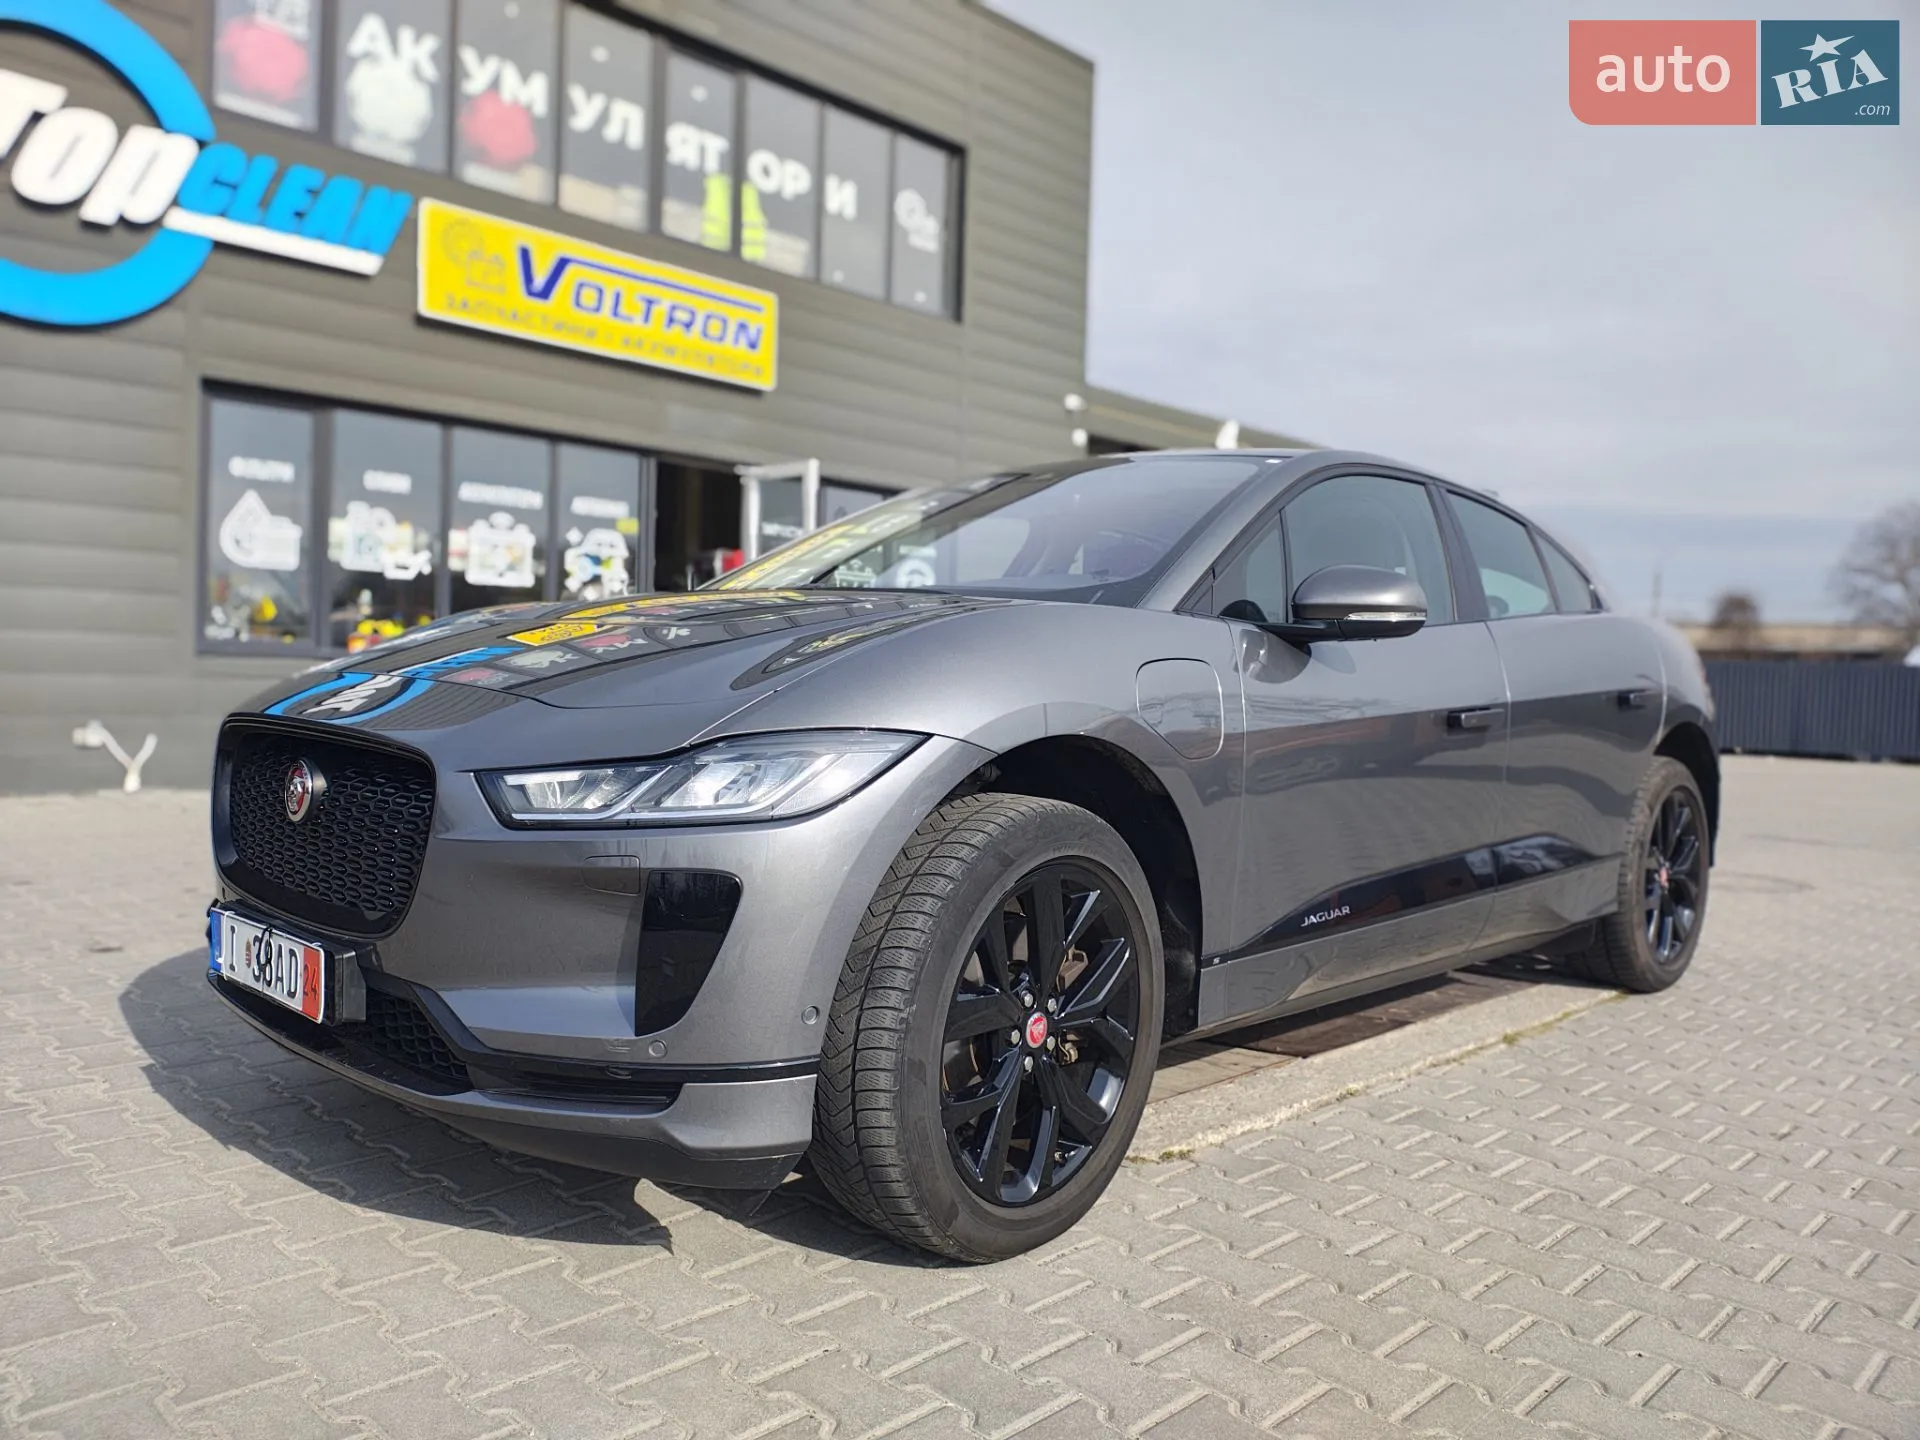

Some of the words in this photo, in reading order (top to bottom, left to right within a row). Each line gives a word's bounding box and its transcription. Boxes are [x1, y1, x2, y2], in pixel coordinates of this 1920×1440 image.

[178, 142, 414, 256] CLEAN
[518, 244, 764, 353] VOLTRON
[1300, 905, 1351, 927] JAGUAR
